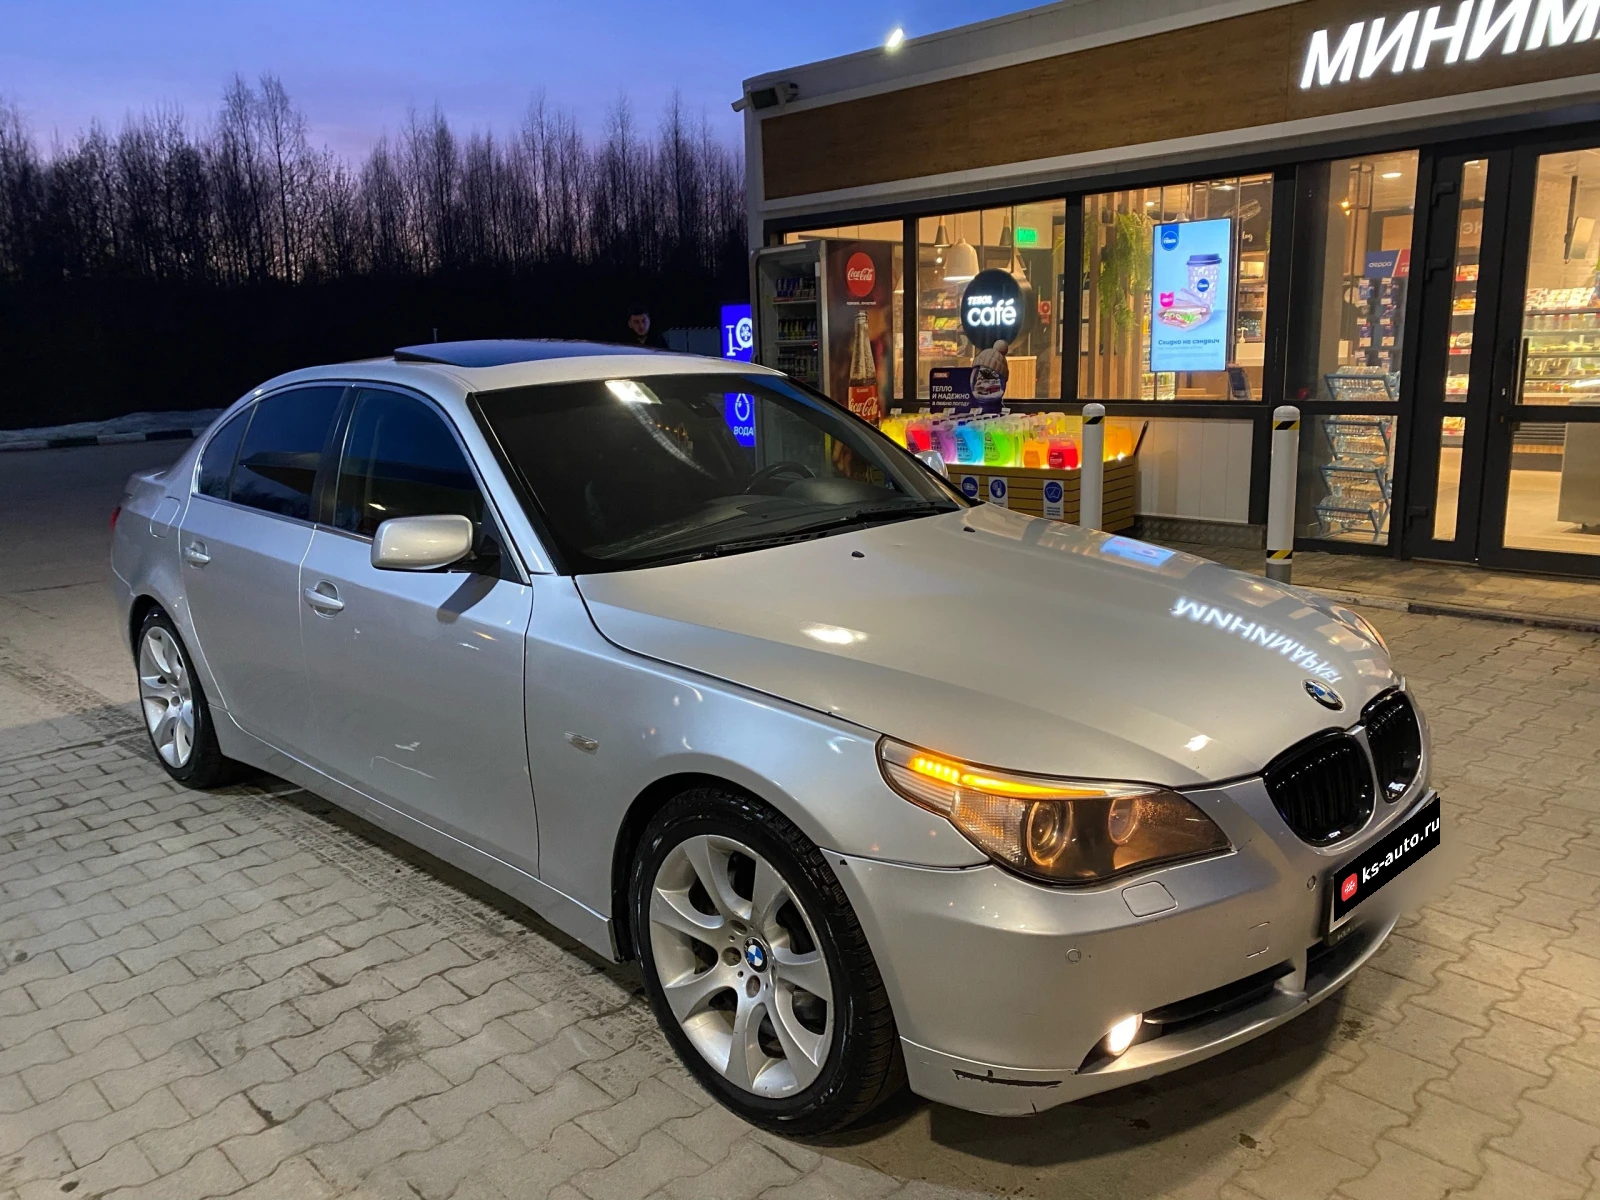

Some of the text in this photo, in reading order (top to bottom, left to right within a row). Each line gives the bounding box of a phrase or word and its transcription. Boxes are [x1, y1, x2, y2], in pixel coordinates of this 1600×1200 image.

[1300, 0, 1600, 89] МИНИМ
[967, 298, 1017, 327] café
[937, 392, 970, 400] НАДЕЖНО
[733, 426, 754, 436] ВОДА
